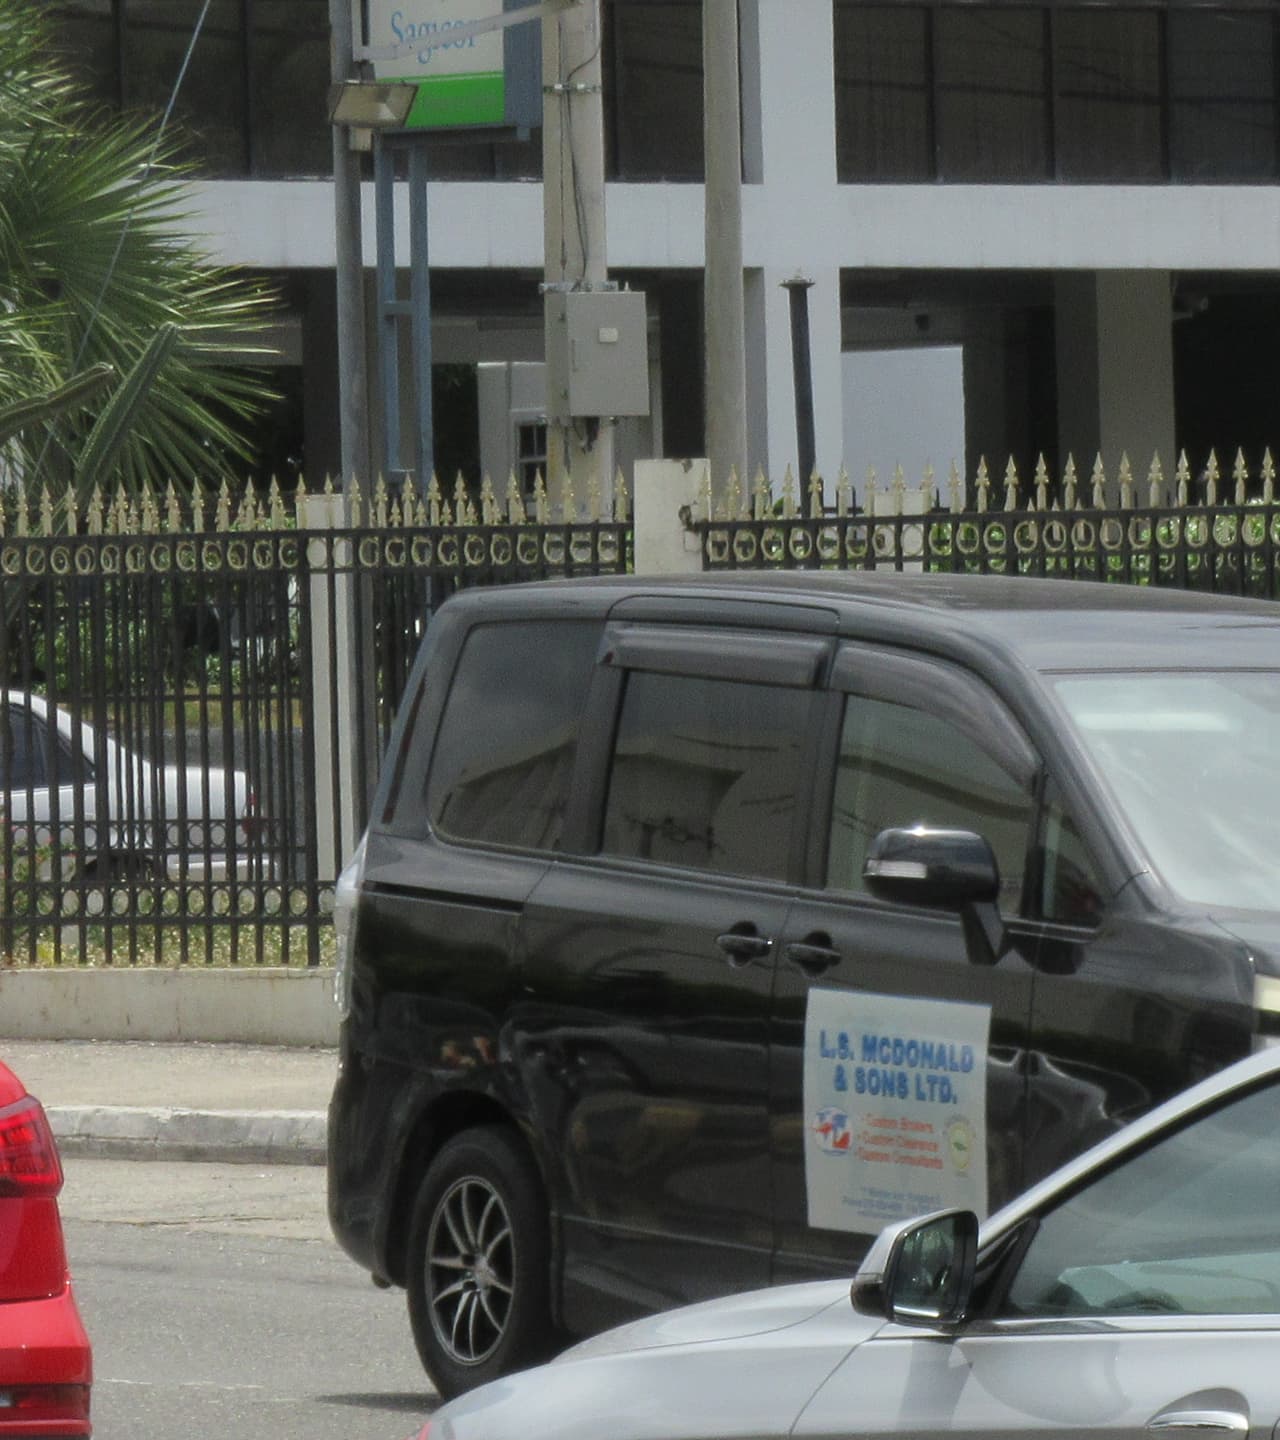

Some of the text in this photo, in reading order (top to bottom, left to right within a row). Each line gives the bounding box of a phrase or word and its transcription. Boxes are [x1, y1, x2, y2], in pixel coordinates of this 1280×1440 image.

[861, 1034, 974, 1074] MCDONALD
[833, 1064, 958, 1105] & SONS LTD.
